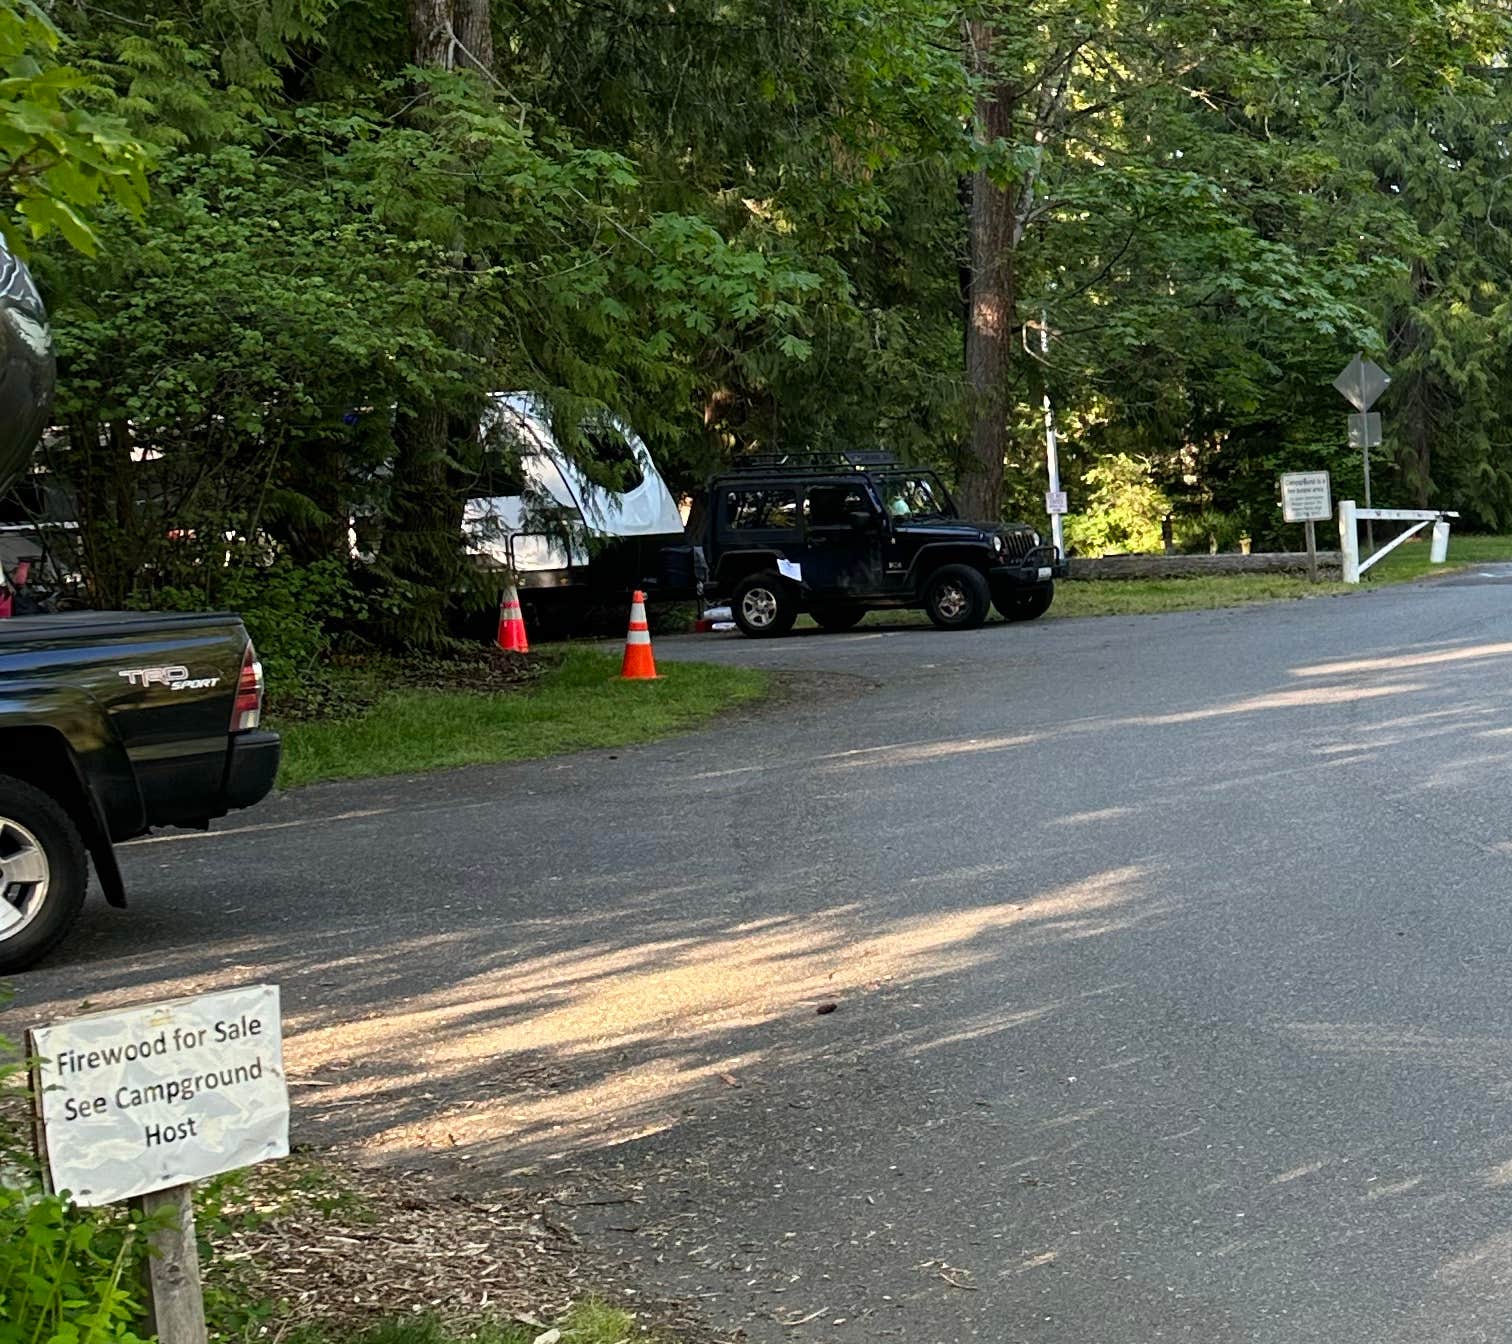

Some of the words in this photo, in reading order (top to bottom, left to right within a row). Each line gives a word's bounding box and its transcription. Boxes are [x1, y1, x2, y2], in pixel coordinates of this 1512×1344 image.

[118, 664, 189, 688] TRD
[170, 676, 220, 691] SPORT
[56, 1031, 166, 1076] Firewood
[172, 1026, 208, 1049] for
[214, 1016, 262, 1043] Sale
[64, 1096, 108, 1122] See
[115, 1056, 262, 1110] Campground
[145, 1118, 198, 1148] Host
